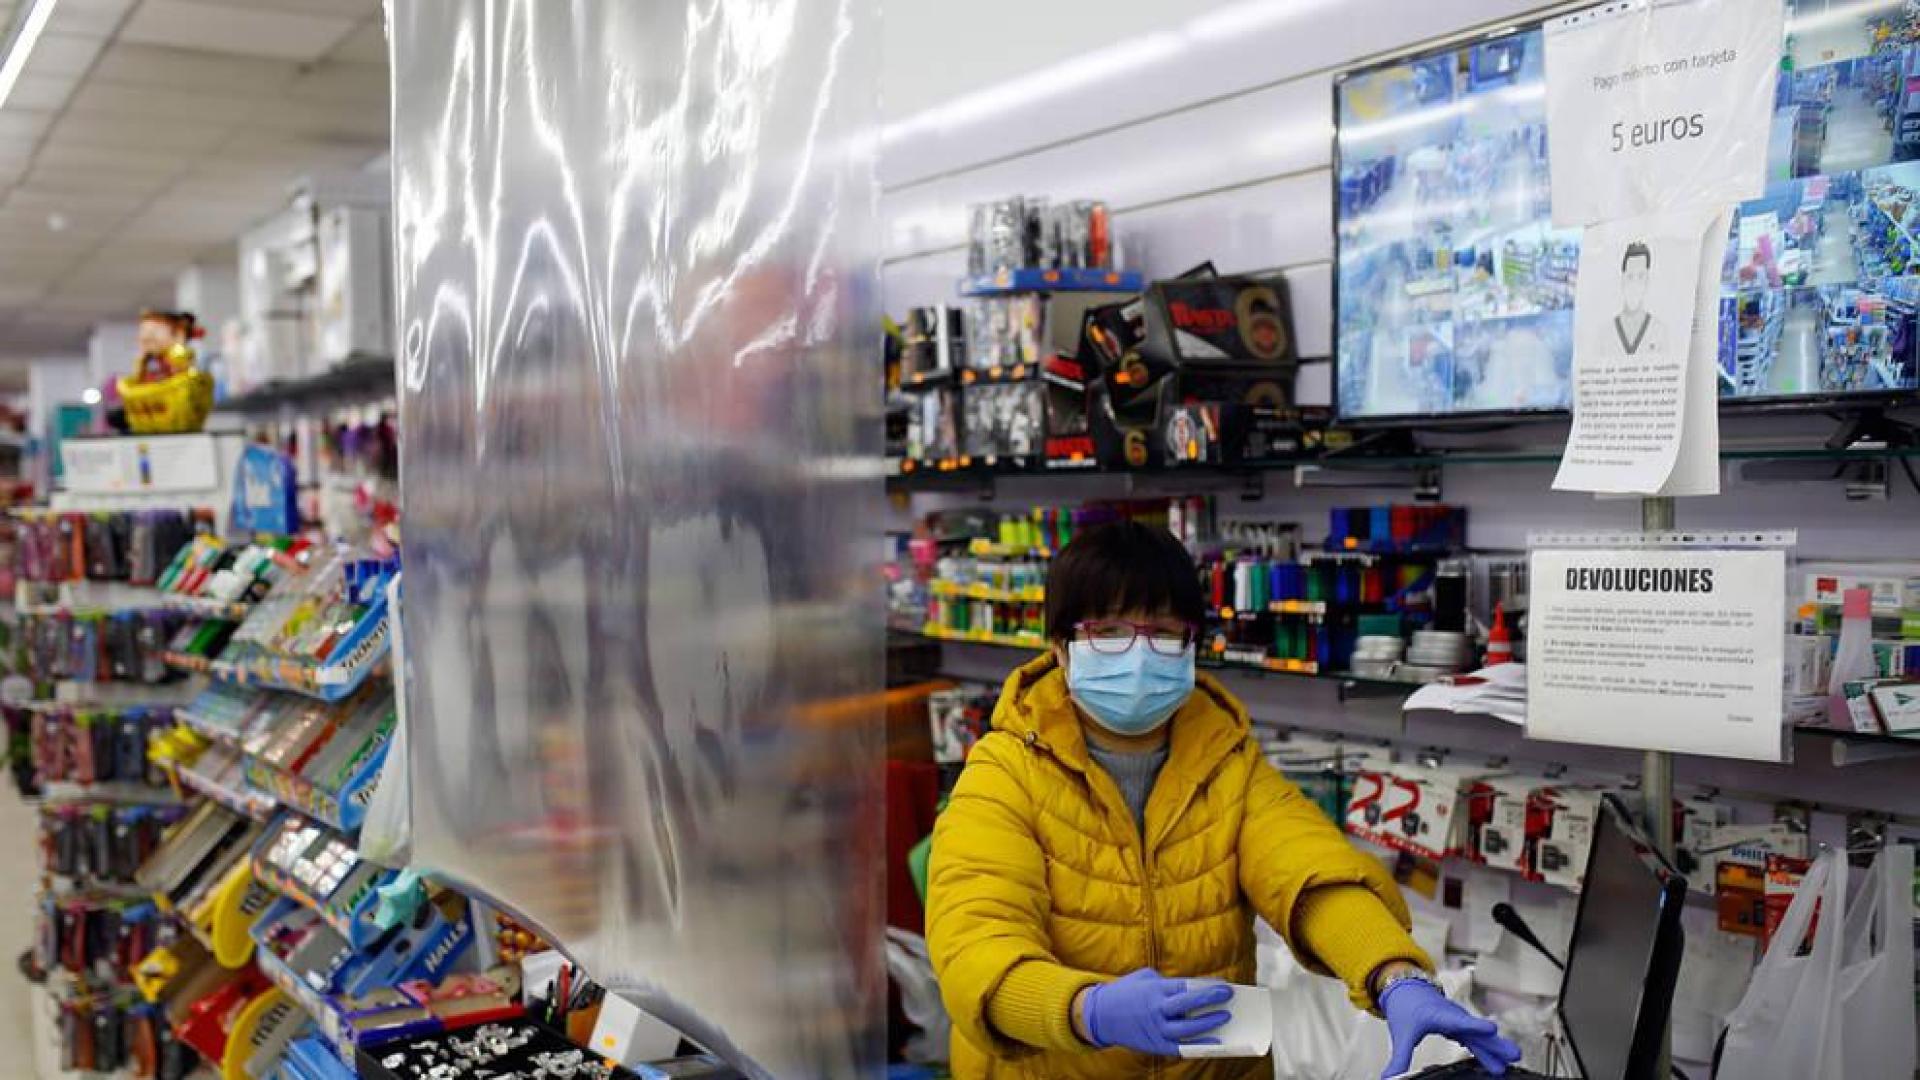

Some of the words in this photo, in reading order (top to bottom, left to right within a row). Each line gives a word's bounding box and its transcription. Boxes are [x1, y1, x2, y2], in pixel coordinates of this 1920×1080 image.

[1593, 74, 1619, 92] Pago
[1663, 58, 1687, 73] con
[1692, 48, 1737, 69] tarjeta
[1612, 122, 1624, 152] 5
[1630, 113, 1704, 147] euros
[1566, 567, 1713, 593] DEVOLUCIONES
[424, 919, 468, 974] HALLS
